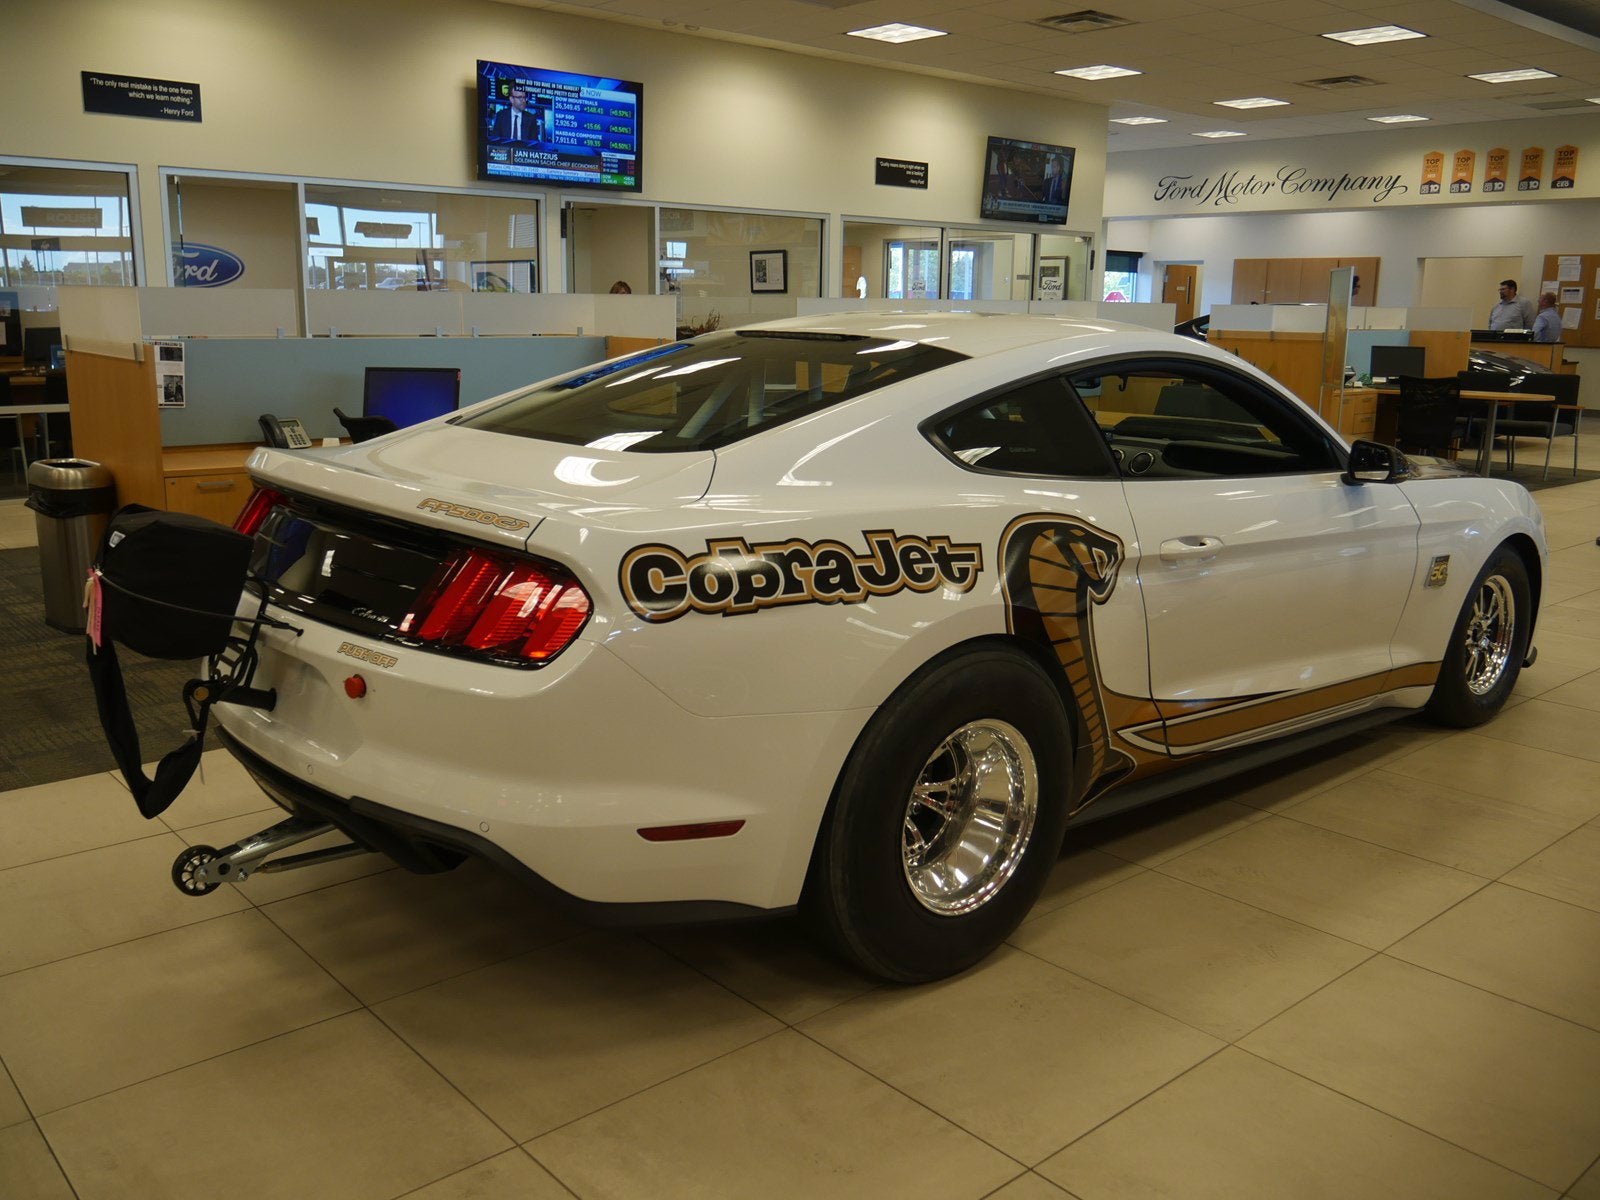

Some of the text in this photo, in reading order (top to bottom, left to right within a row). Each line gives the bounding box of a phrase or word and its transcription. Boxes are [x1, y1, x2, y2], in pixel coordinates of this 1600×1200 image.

[105, 80, 117, 89] only
[118, 81, 129, 89] real
[130, 82, 152, 92] mistake
[152, 84, 158, 92] is
[159, 85, 168, 93] the
[180, 87, 193, 95] from
[128, 90, 145, 99] which
[568, 98, 598, 106] INDUSTRIALS
[164, 107, 180, 117] Henry
[181, 108, 194, 117] Ford
[576, 132, 602, 140] COMPOSITE
[514, 150, 528, 158] JAN
[530, 151, 558, 160] HATZIUS
[1457, 156, 1471, 164] TOP
[1154, 165, 1409, 206] Ford Motor Company
[1042, 280, 1063, 291] Ford
[369, 651, 399, 668] OFF
